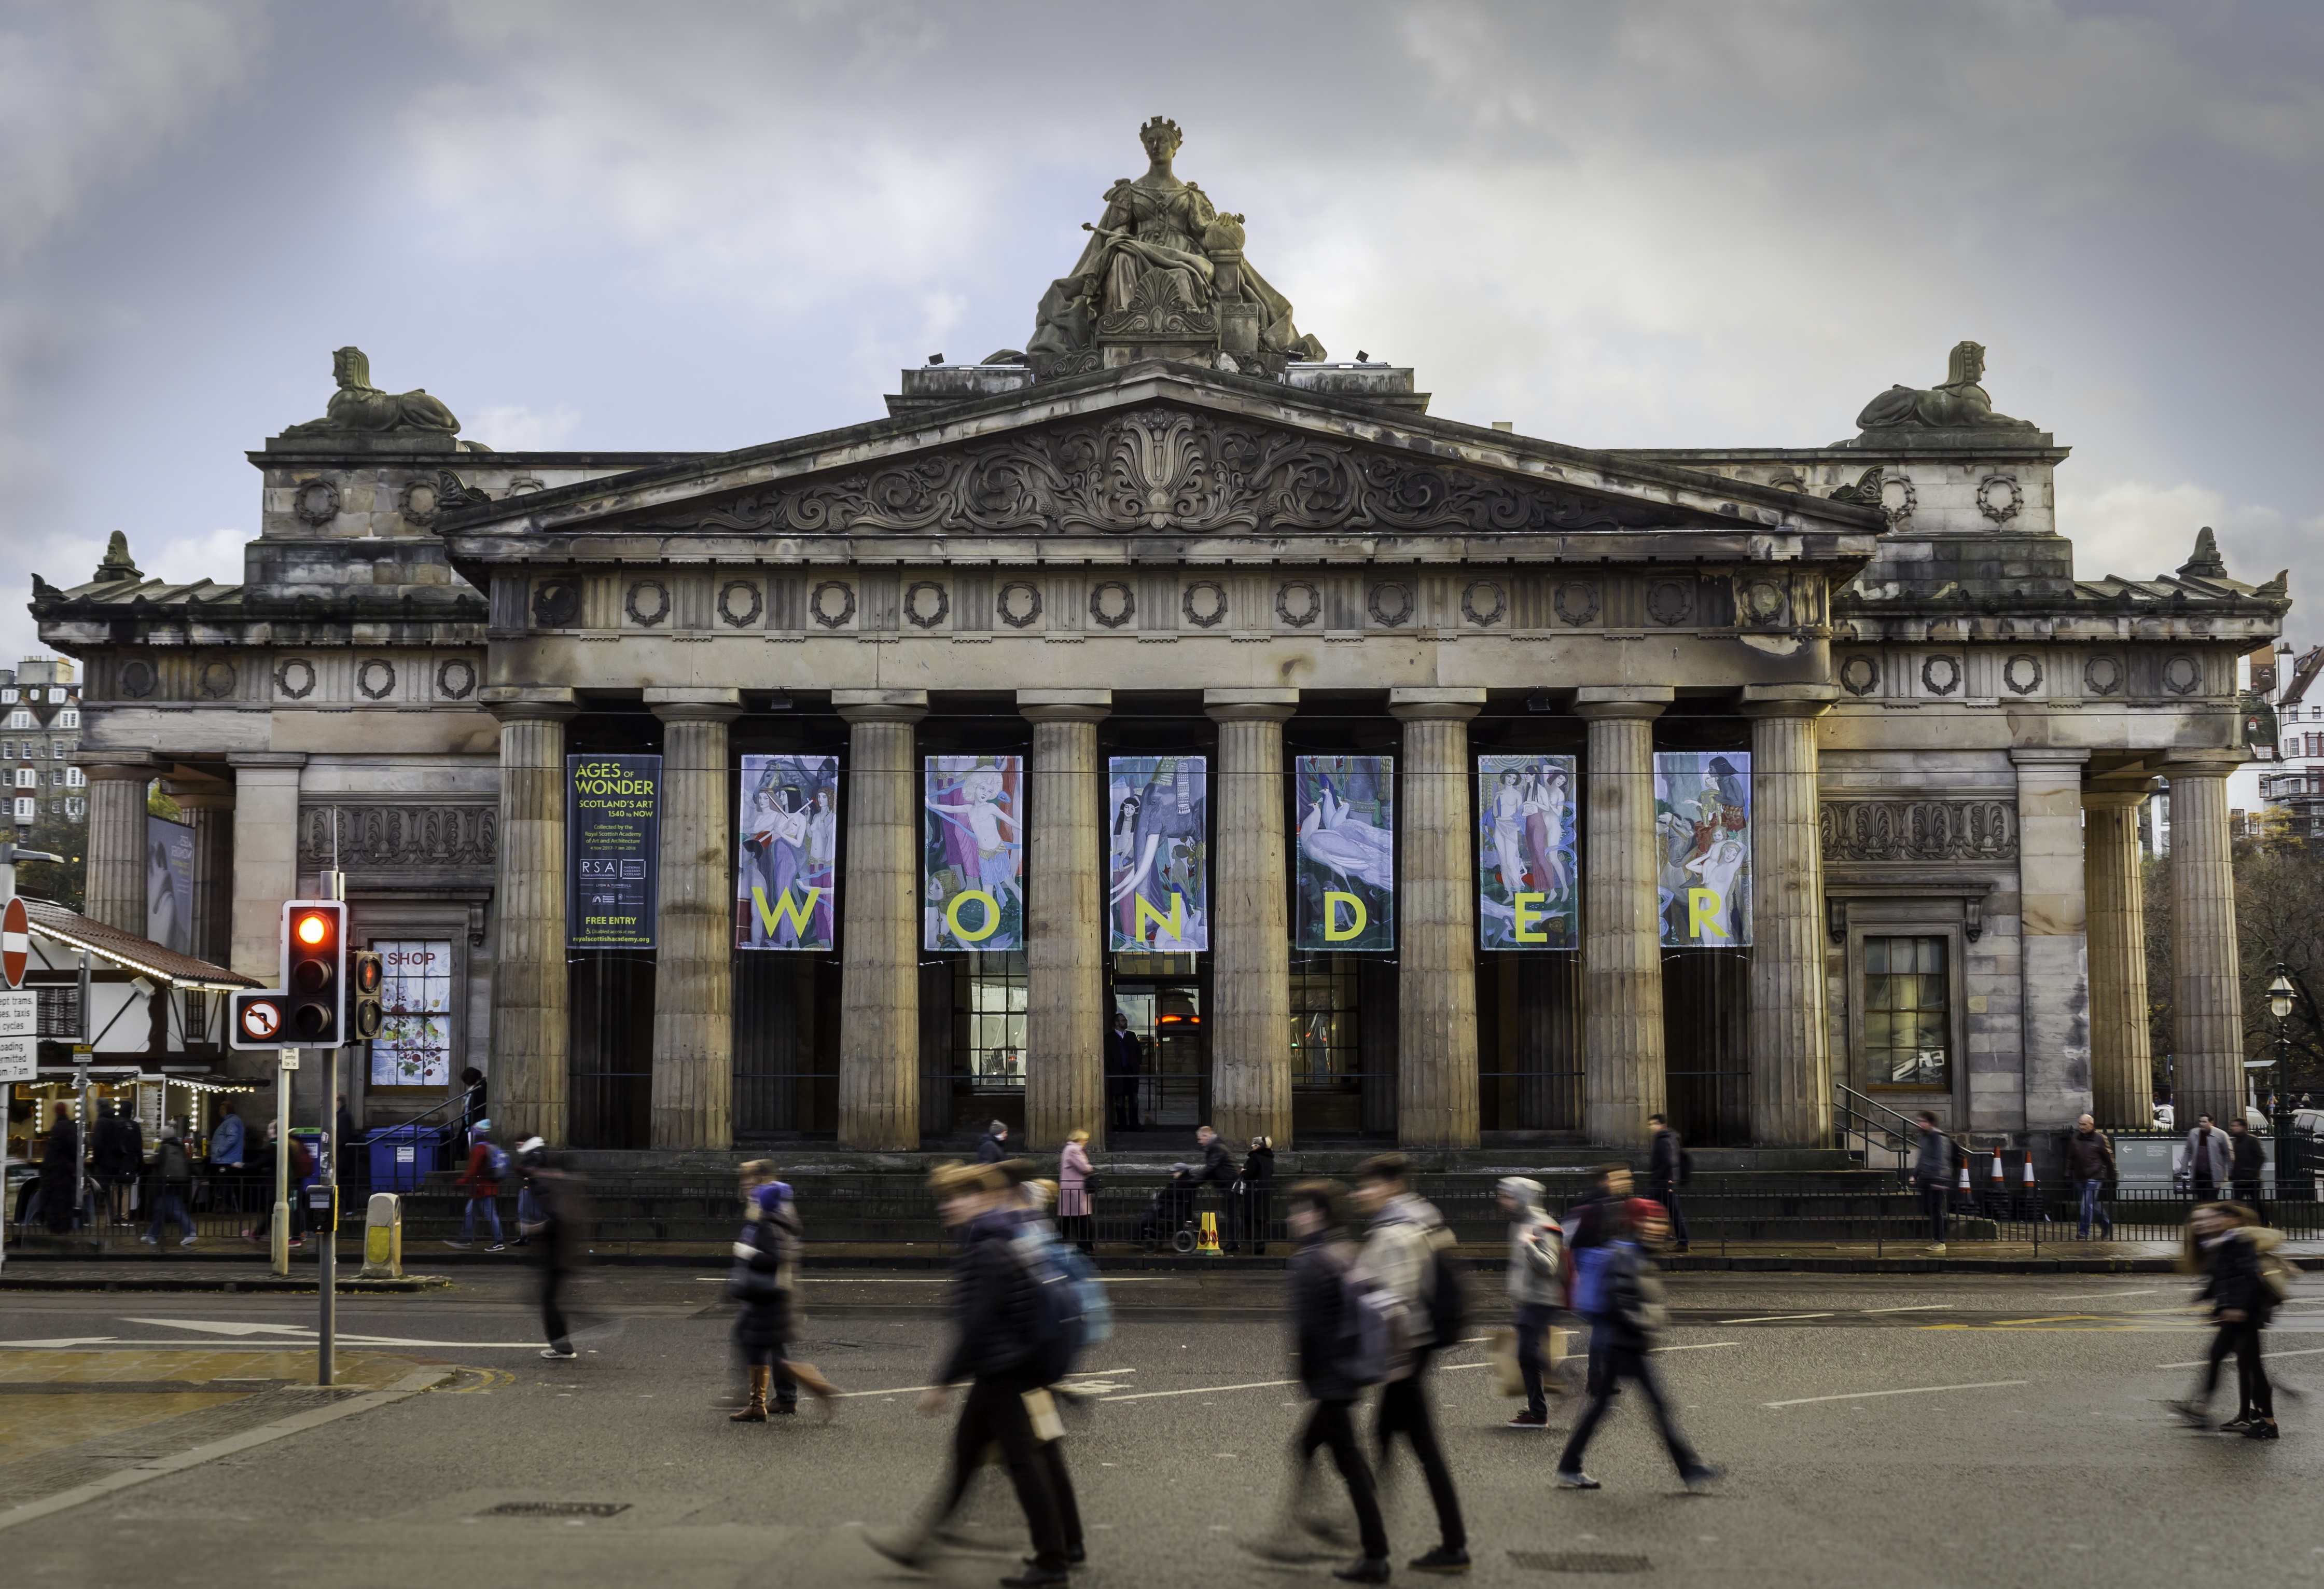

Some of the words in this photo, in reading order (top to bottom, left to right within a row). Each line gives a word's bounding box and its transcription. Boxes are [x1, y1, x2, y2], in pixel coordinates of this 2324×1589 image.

[575, 763, 621, 778] AGES
[575, 780, 654, 795] WONDER
[387, 952, 435, 965] SHOP
[14, 1008, 30, 1017] taxis
[3, 1021, 23, 1032] cycles
[0, 1042, 23, 1052] oading
